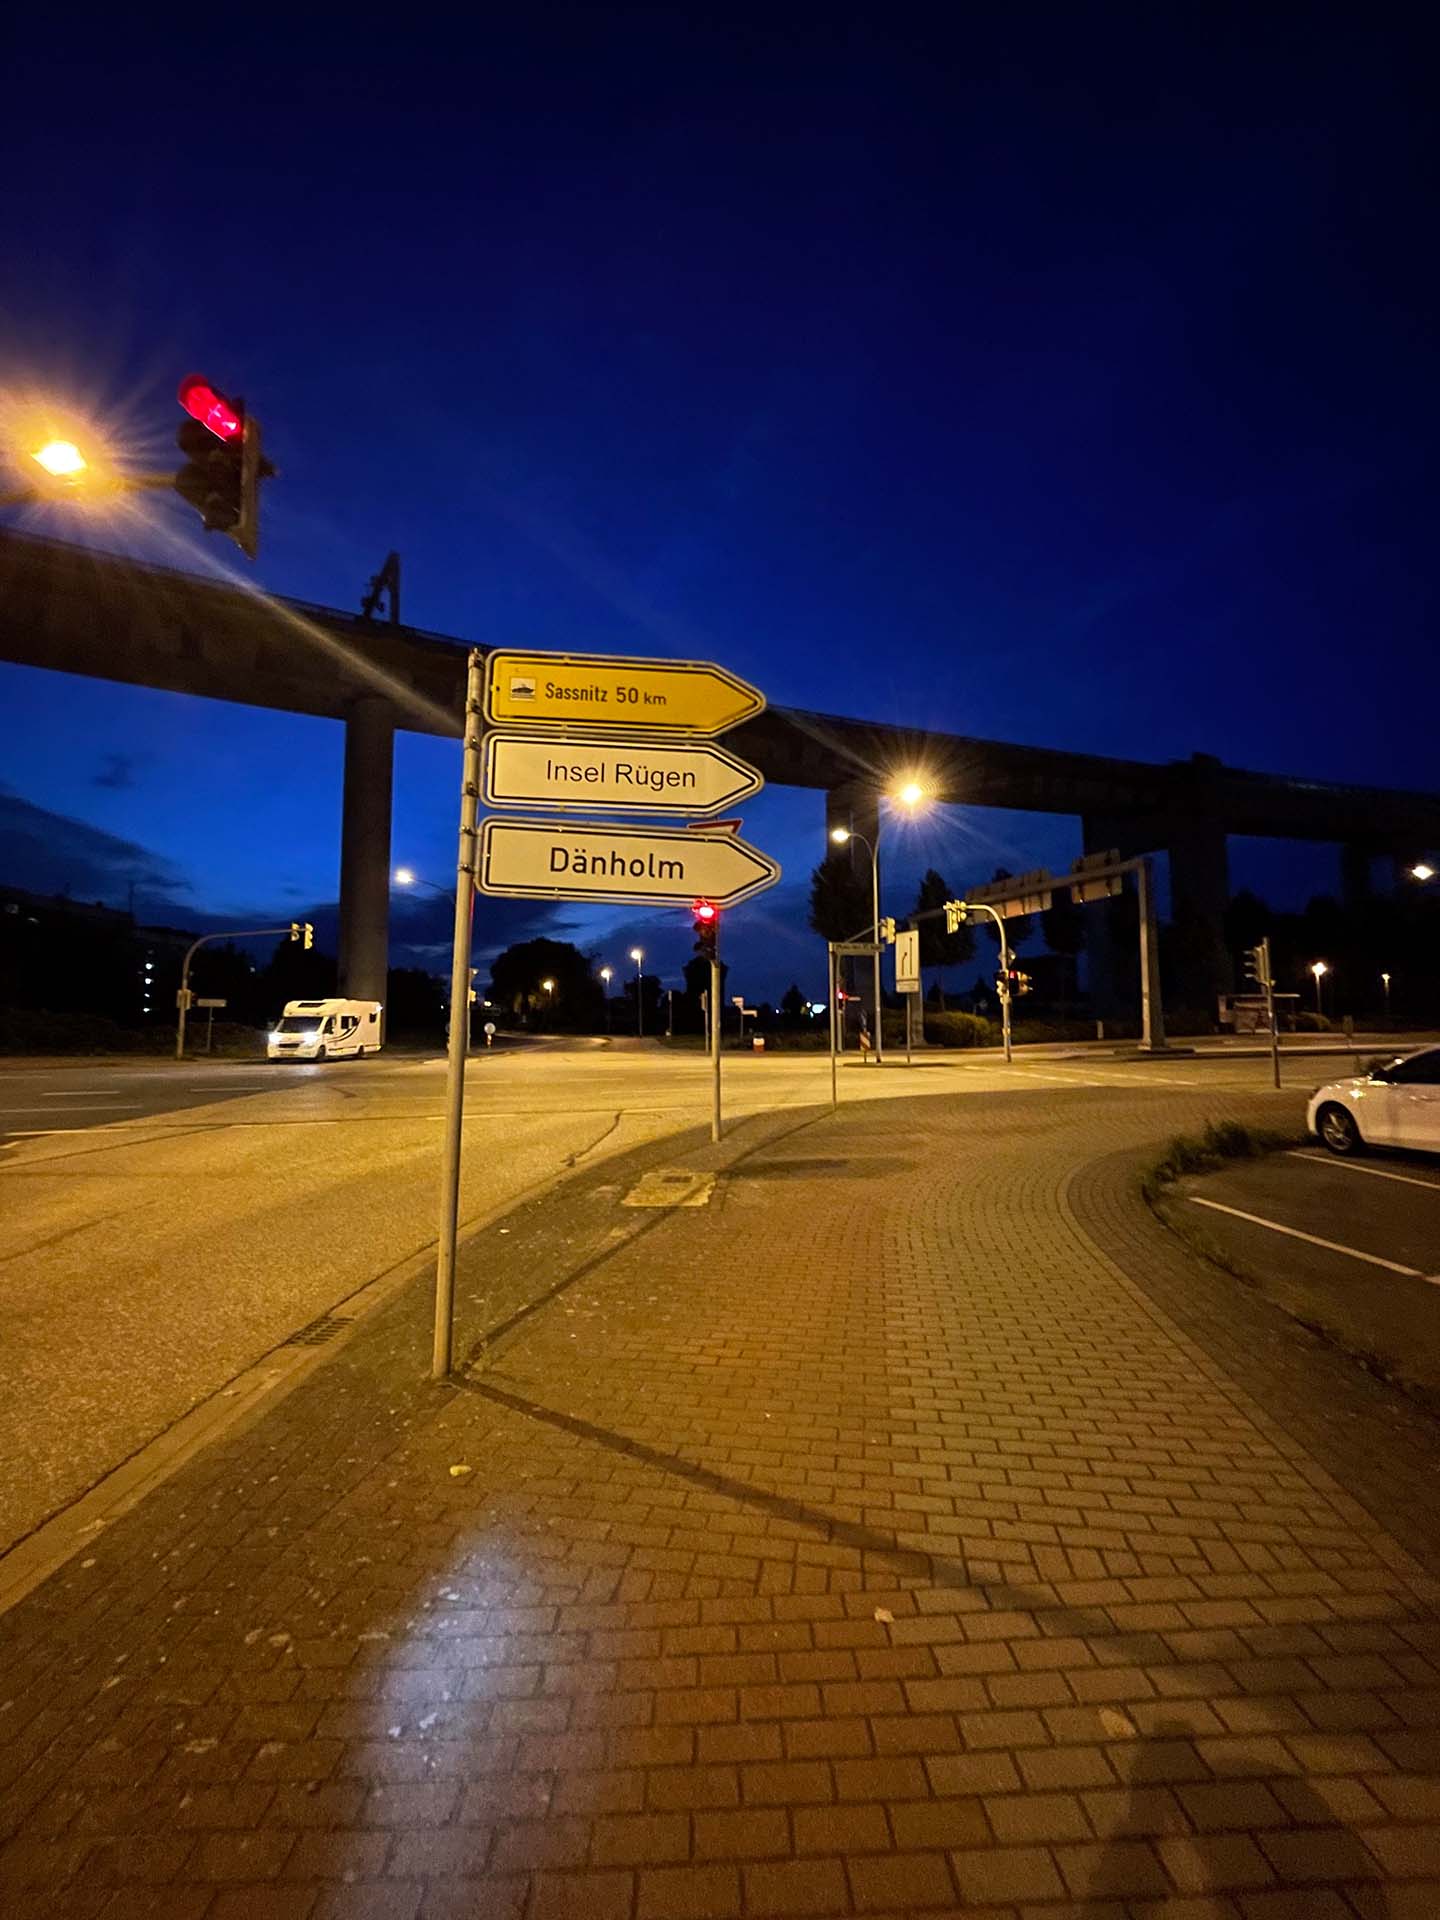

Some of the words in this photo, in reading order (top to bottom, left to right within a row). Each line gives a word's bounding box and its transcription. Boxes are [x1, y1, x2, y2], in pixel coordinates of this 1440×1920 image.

[545, 682, 608, 702] Sassnitz
[616, 687, 639, 704] 50
[643, 692, 667, 705] km
[547, 759, 605, 783] Insel
[615, 763, 696, 792] Rügen
[550, 847, 684, 880] Dänholm
